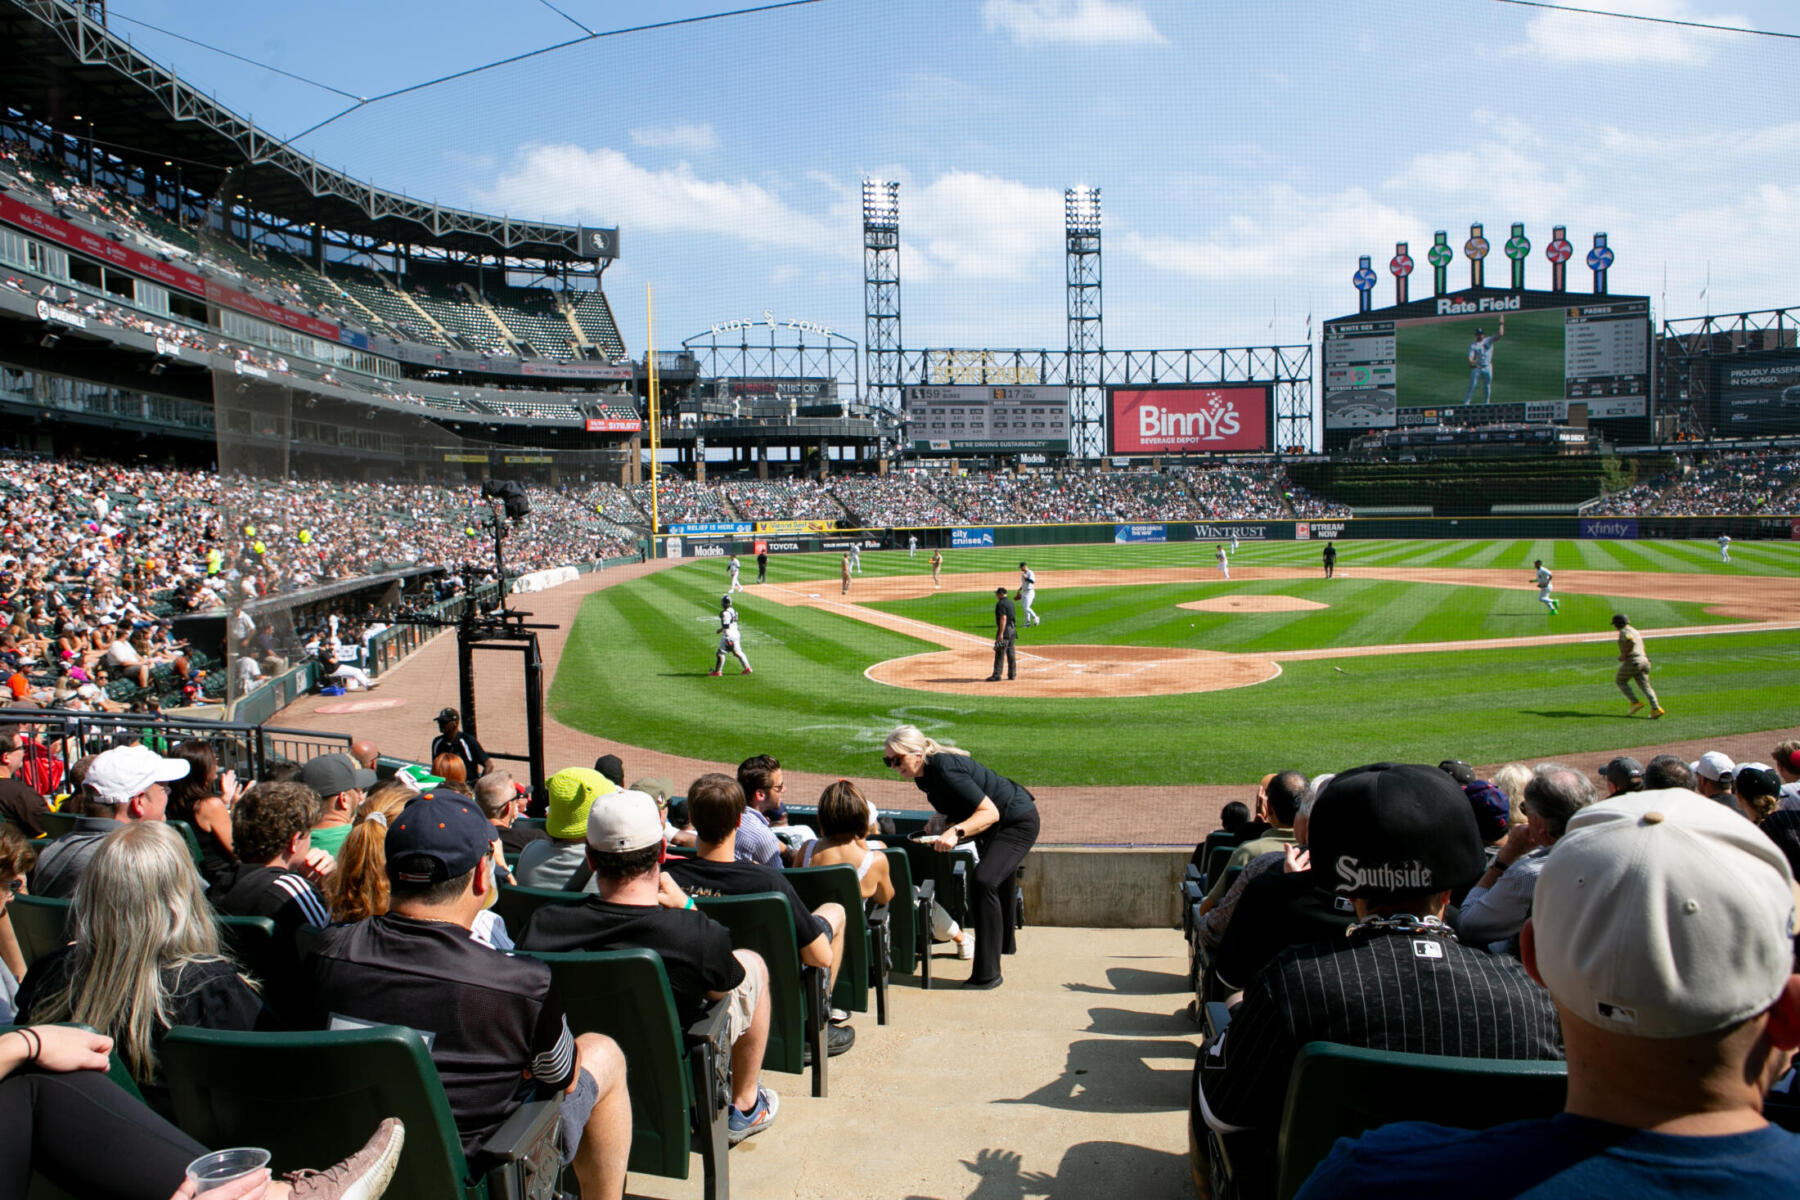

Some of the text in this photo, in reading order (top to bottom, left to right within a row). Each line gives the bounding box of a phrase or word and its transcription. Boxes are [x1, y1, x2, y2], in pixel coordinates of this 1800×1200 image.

[1437, 295, 1521, 315] Rate Field
[711, 317, 833, 338] KIDS ZONE
[1731, 368, 1768, 378] PROUDLY
[926, 389, 940, 399] 59
[1007, 389, 1021, 399] 17
[1176, 436, 1199, 444] DEPOT
[1020, 453, 1046, 463] Modelo
[1194, 525, 1266, 538] WINTRUST
[1311, 523, 1345, 531] STREAM
[1586, 522, 1629, 537] xfinity
[952, 528, 967, 538] city
[1318, 531, 1338, 539] NOW
[952, 535, 982, 545] cruises
[694, 544, 724, 557] Modelo
[769, 543, 799, 551] TOYOTA
[1335, 855, 1432, 893] Southside
